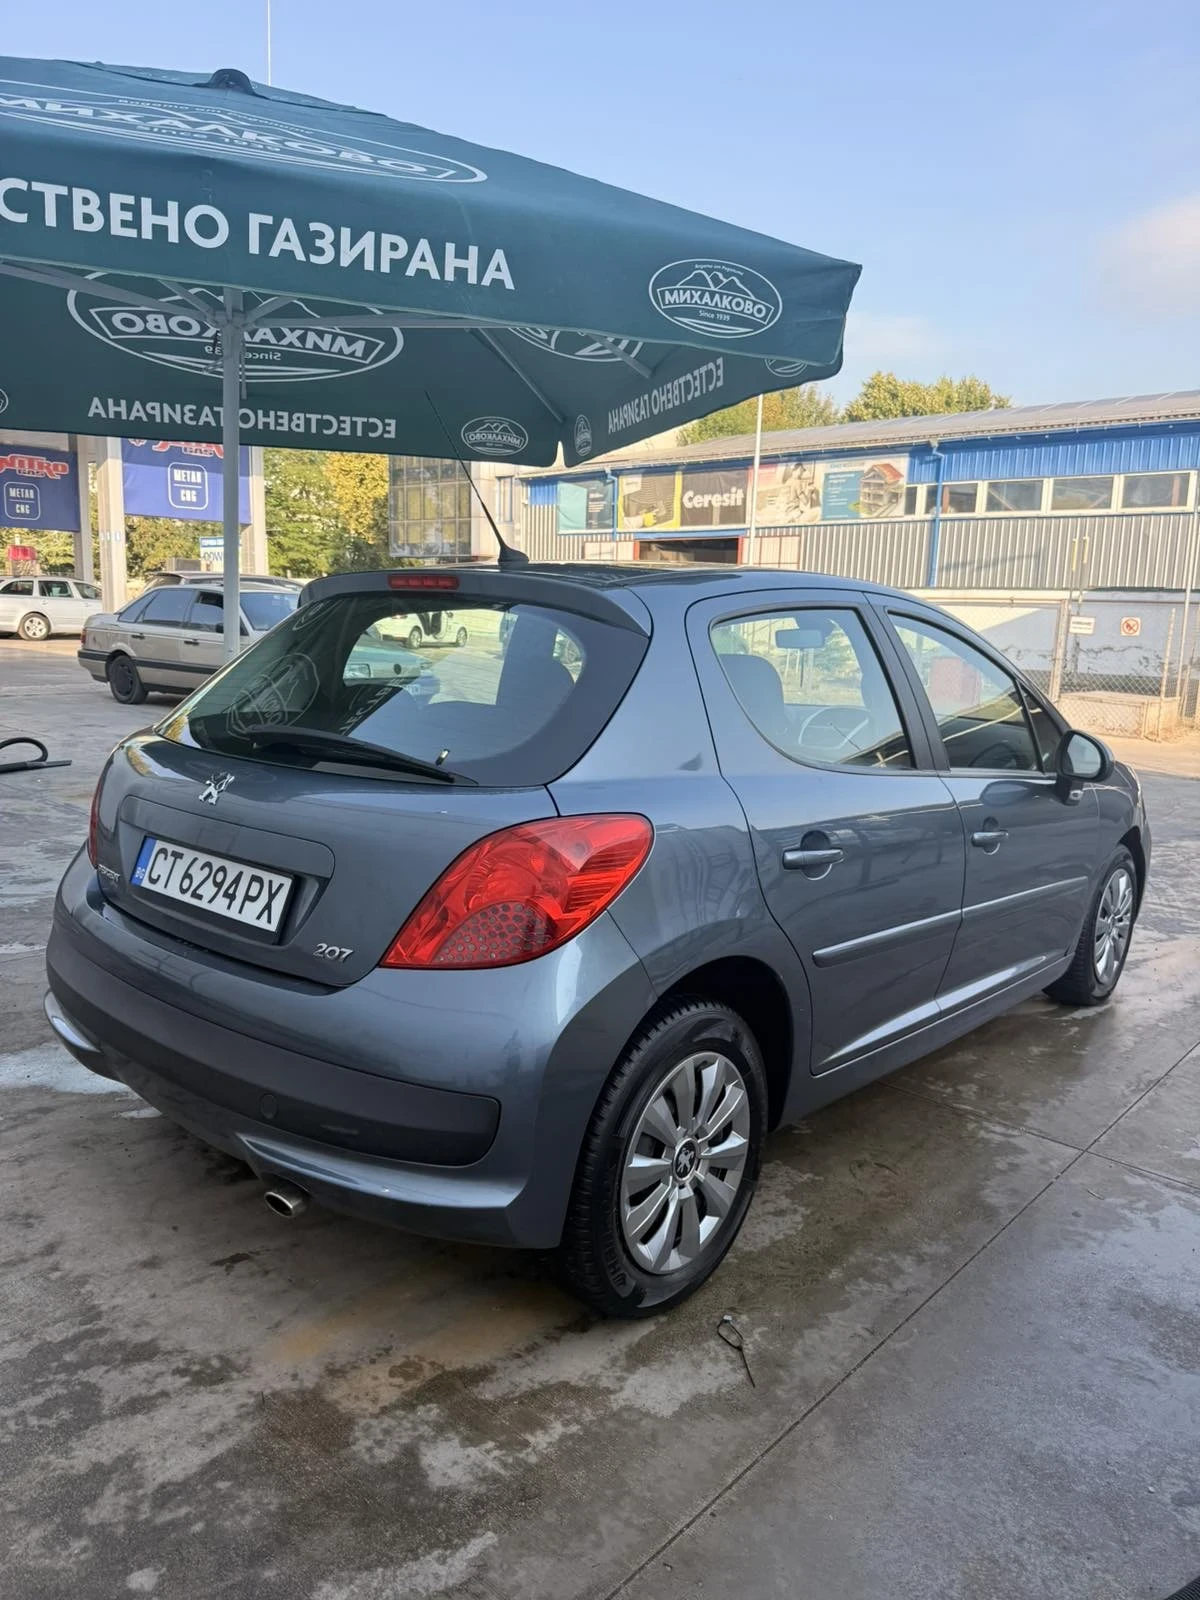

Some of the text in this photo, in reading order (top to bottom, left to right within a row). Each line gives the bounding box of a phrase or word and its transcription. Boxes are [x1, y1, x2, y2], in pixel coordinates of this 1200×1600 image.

[0, 177, 515, 291] СТВЕНО ГАЗИРАНА
[664, 289, 766, 319] МИХАЛКОВО
[699, 310, 715, 320] Since
[682, 486, 744, 509] Ceresit
[313, 943, 354, 963] 207
